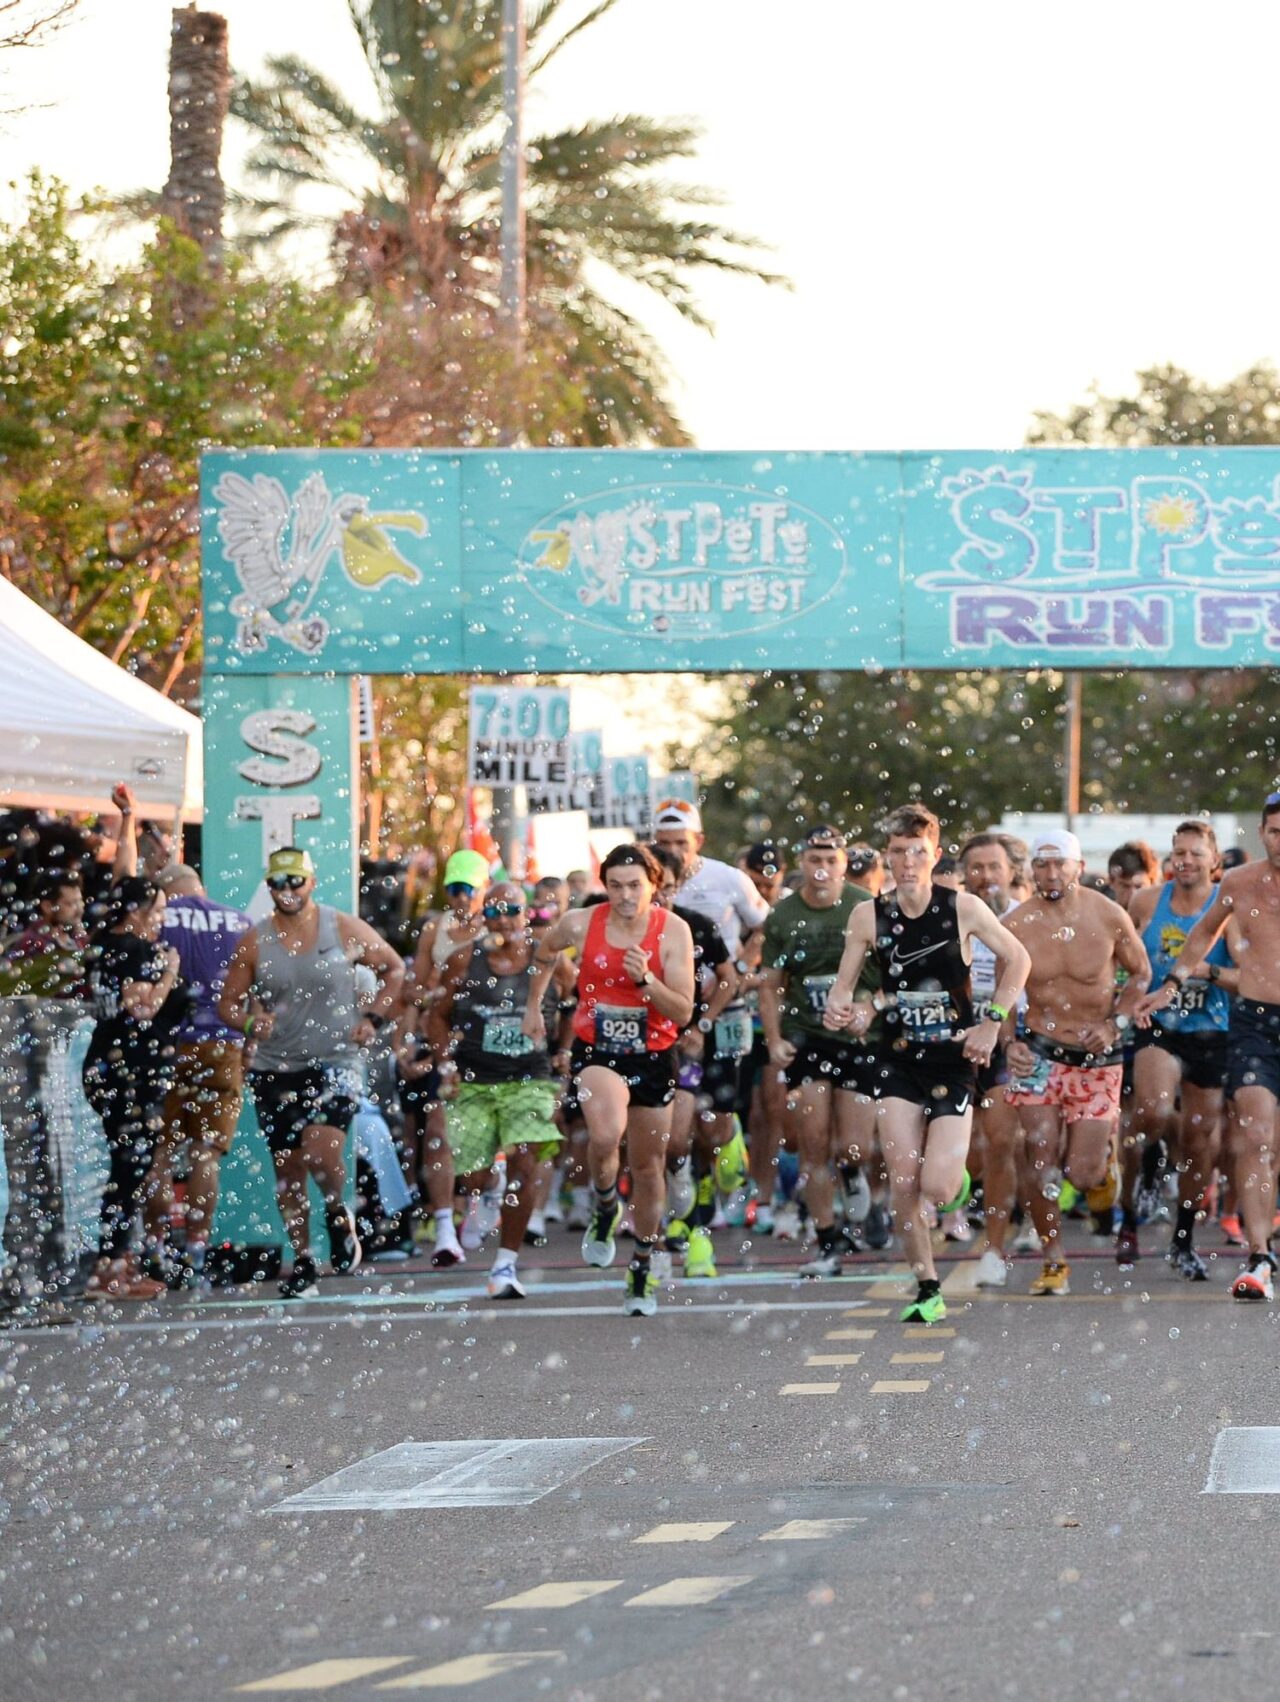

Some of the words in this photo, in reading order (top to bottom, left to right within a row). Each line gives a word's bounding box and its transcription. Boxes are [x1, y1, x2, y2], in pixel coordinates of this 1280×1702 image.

[474, 694, 570, 740] 7:00
[475, 740, 566, 756] MINUTE
[474, 761, 566, 782] MILE
[163, 907, 240, 932] STAFF
[602, 1020, 639, 1038] 929
